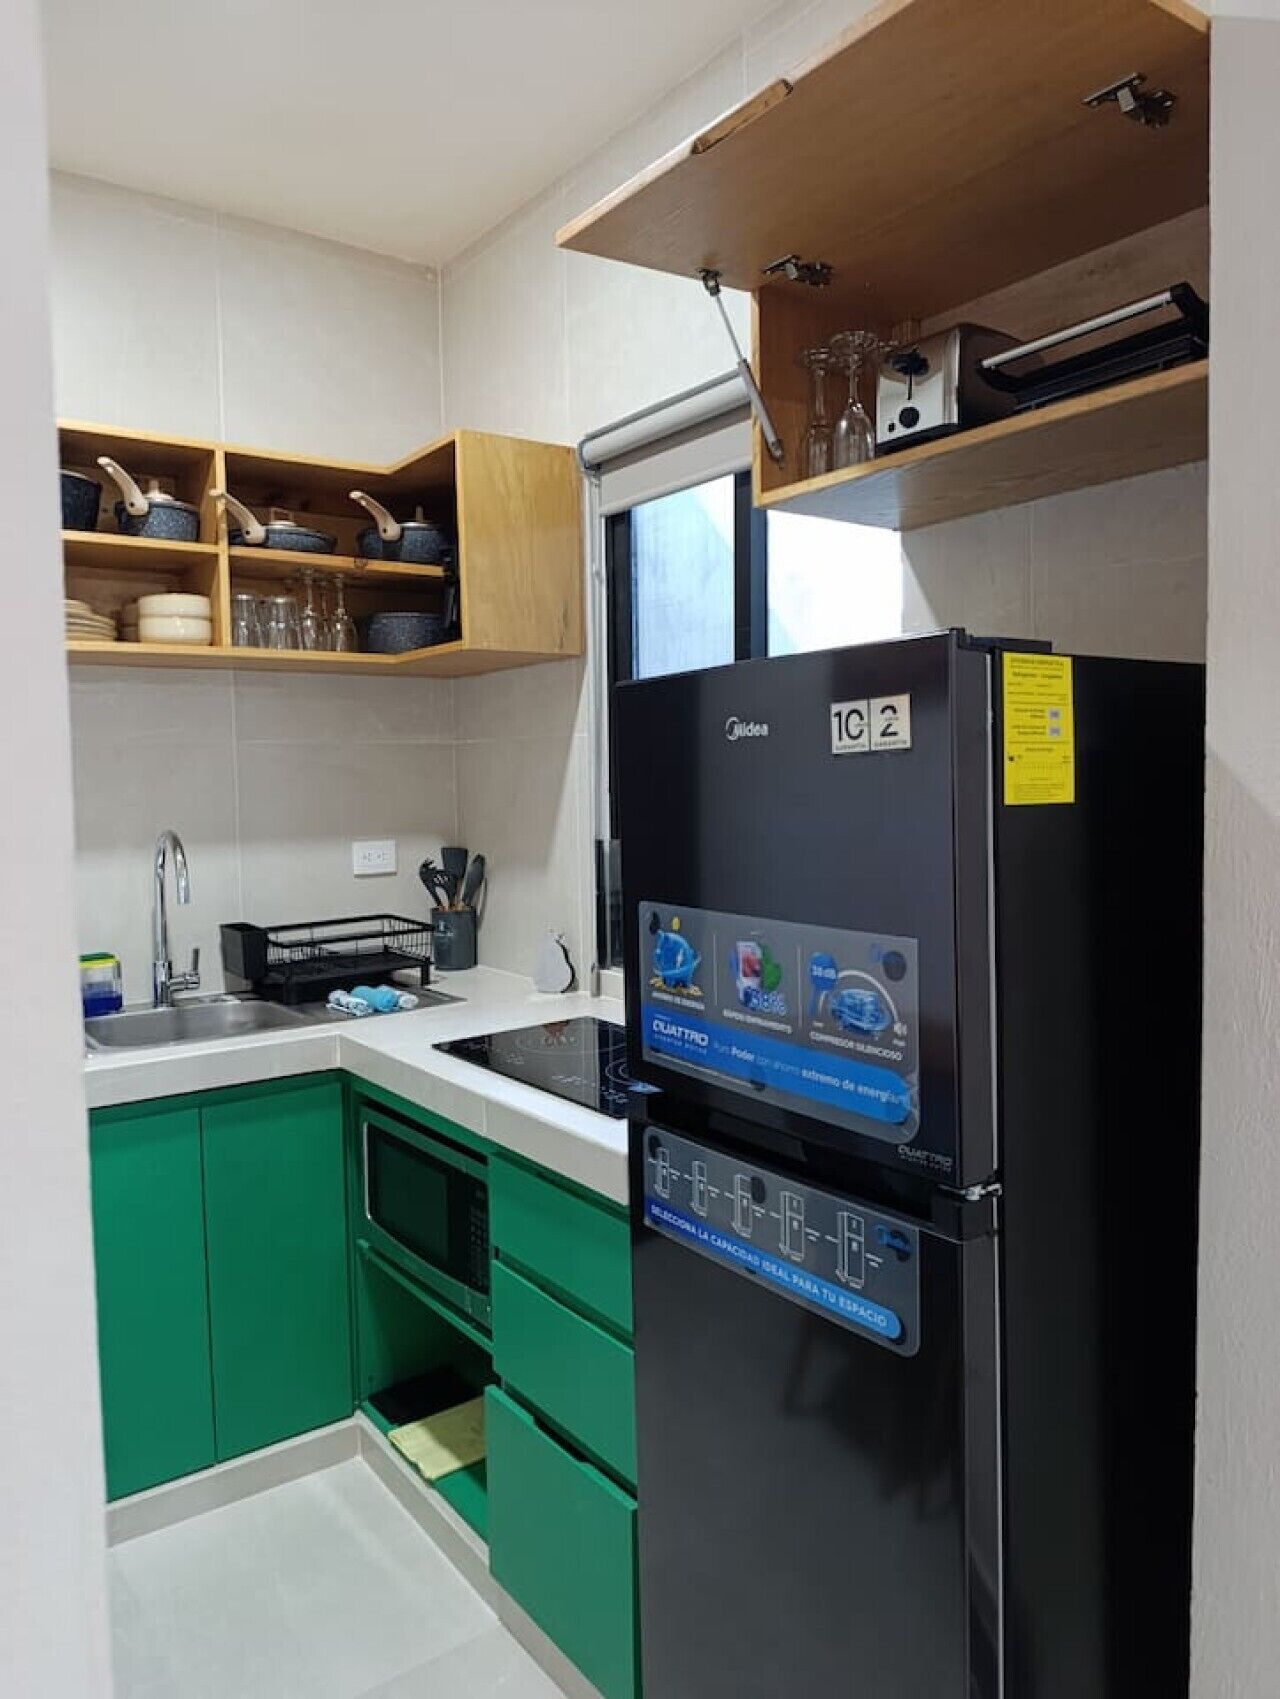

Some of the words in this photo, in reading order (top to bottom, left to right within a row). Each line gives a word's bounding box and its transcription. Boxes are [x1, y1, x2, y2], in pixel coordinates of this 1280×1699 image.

[726, 716, 769, 741] Midea
[880, 705, 898, 737] 2
[652, 1019, 709, 1047] QUATTRO
[699, 1227, 709, 1240] LA
[822, 1289, 837, 1303] TU
[838, 1297, 888, 1327] ESPACIO
